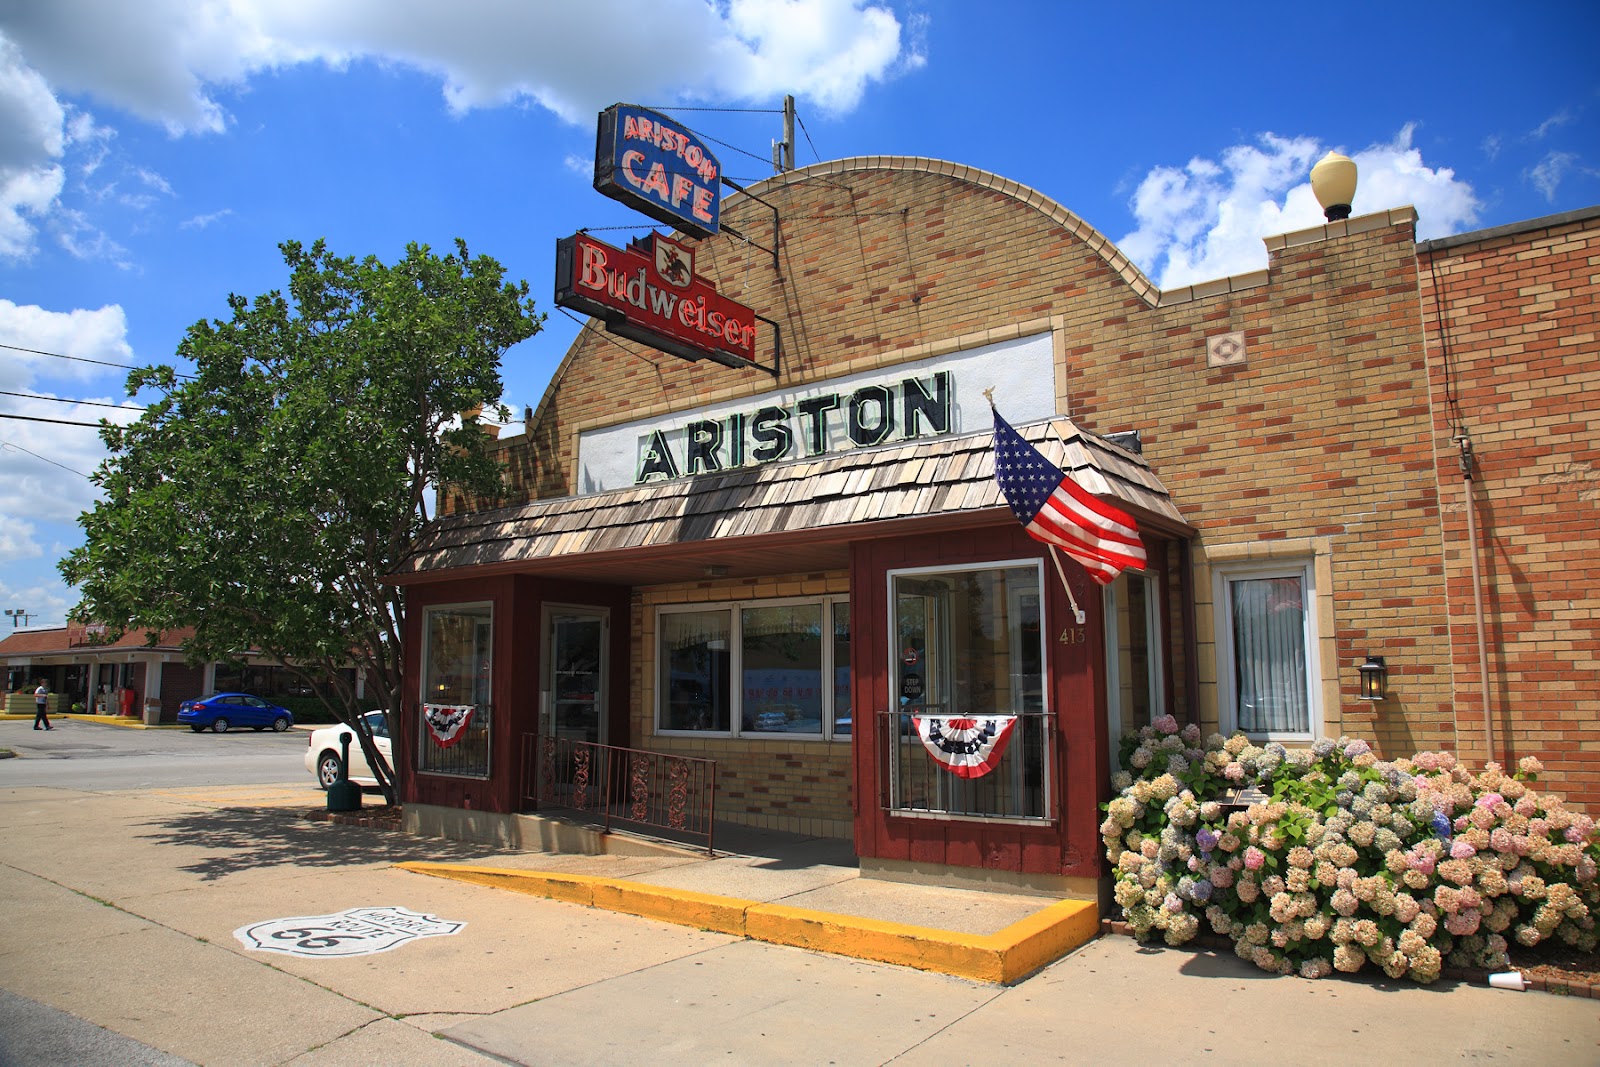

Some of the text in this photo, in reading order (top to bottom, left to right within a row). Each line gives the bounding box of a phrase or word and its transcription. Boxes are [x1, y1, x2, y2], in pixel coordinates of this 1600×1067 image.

[624, 115, 717, 184] ARISTON
[621, 149, 714, 224] CAFE
[578, 241, 758, 350] Budweiser
[633, 370, 952, 485] ARISTON
[1059, 628, 1085, 645] 413
[904, 686, 921, 694] DOWN
[906, 678, 919, 686] STEP
[325, 920, 396, 938] ROUTE
[360, 912, 438, 932] HISTORIC
[271, 927, 366, 949] 66
